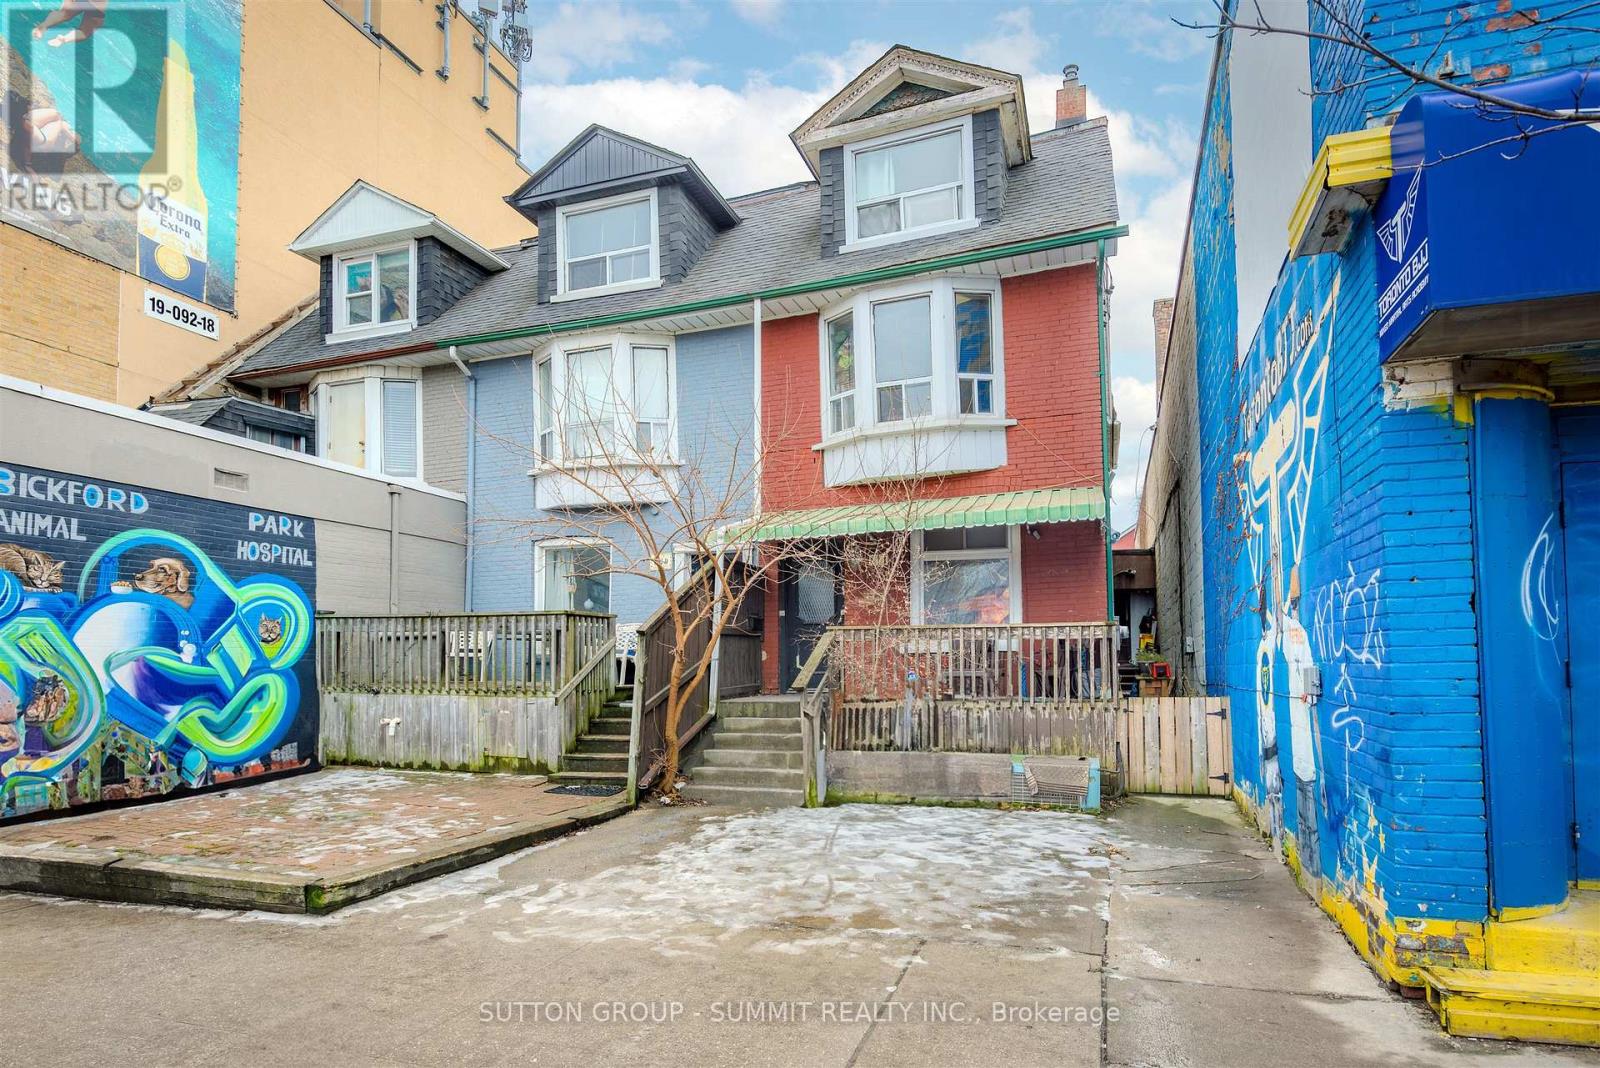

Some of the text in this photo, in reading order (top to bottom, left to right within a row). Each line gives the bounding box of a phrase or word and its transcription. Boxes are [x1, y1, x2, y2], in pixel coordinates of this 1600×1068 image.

[160, 213, 191, 239] Extra
[1378, 242, 1429, 318] TORONTO BJJ
[149, 296, 215, 333] 19-092-18
[0, 466, 305, 539] BICKFORD PARK
[0, 508, 313, 568] ANIMAL HOSPITAL
